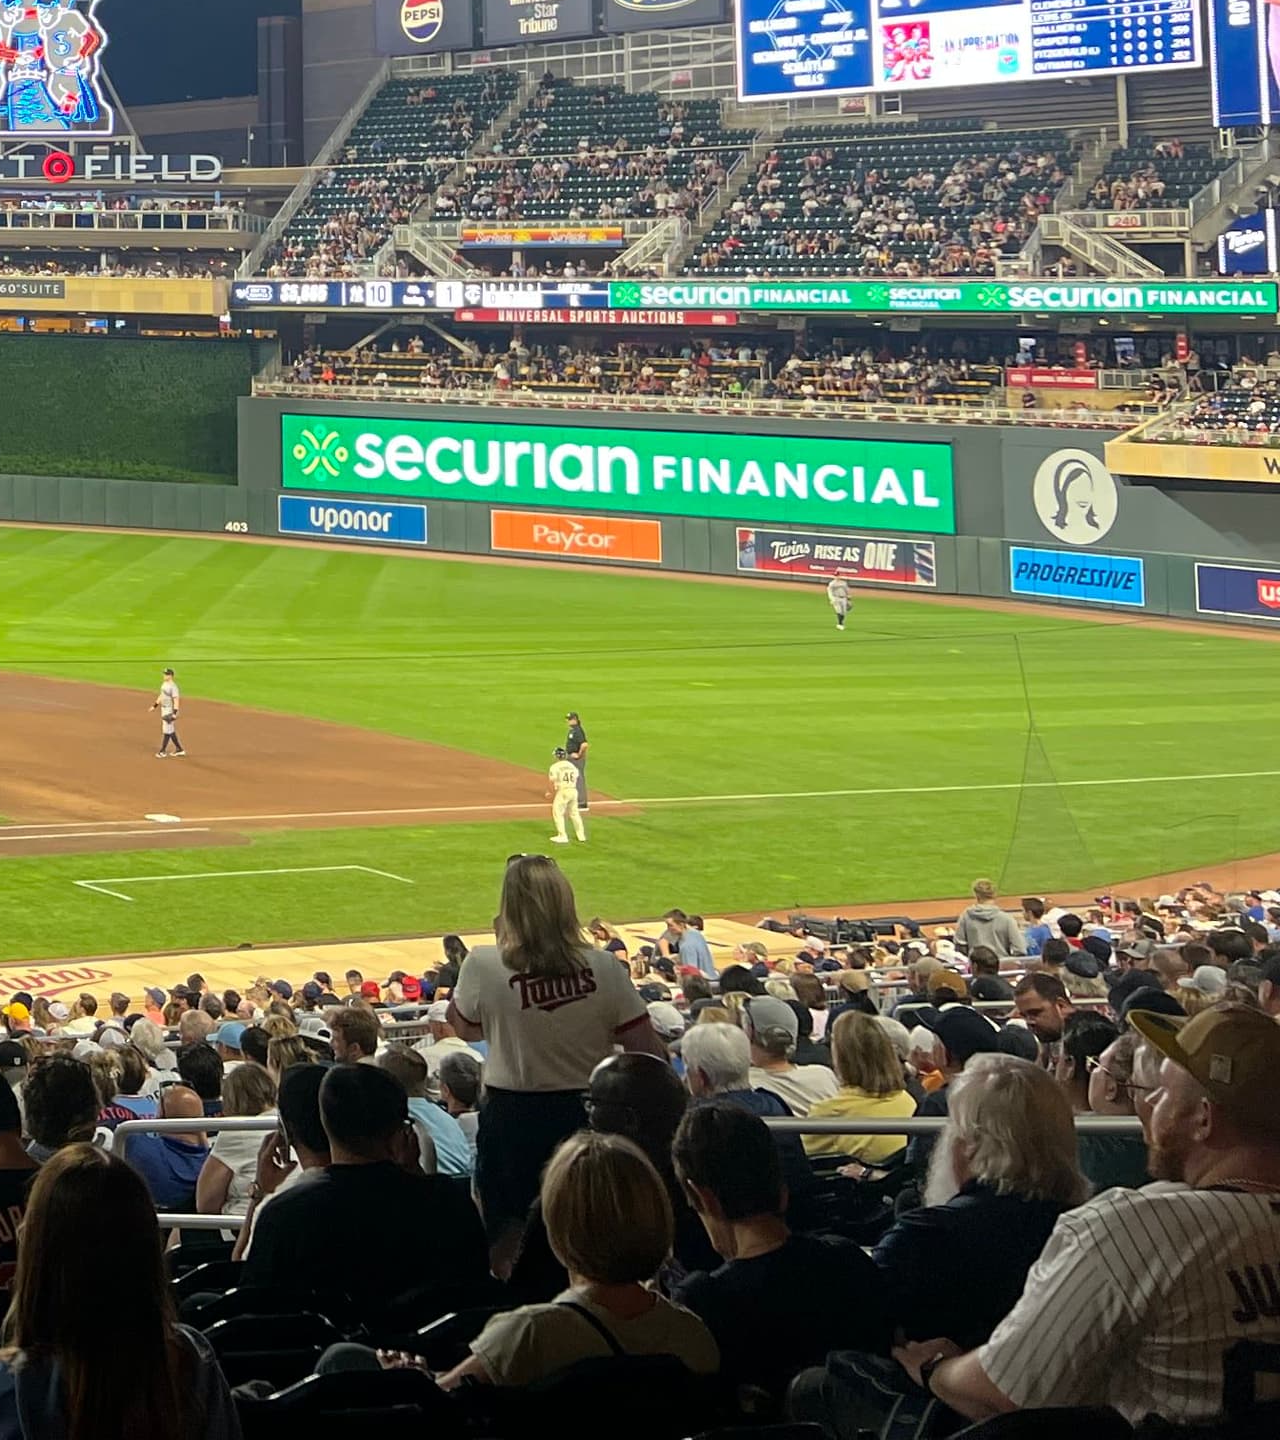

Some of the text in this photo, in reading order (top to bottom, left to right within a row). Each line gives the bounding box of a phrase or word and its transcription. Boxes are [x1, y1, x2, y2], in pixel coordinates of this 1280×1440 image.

[405, 7, 441, 23] PEPSI
[534, 2, 559, 18] Star
[518, 16, 558, 35] Tribune
[84, 155, 222, 181] FIELD
[21, 282, 59, 295] SUITE
[640, 283, 1268, 308] securian FINANCIAL securian securian FINANCIAL
[498, 309, 685, 324] UNIVERSAL SPORTS AUCTIONS
[352, 432, 940, 508] securian FINANCIAL
[224, 521, 248, 533] 403
[309, 505, 394, 535] uponor
[532, 522, 616, 552] Paycor
[770, 540, 810, 563] Twins
[814, 544, 842, 561] RISE
[843, 546, 860, 562] AS
[863, 542, 898, 570] ONE
[1015, 561, 1137, 591] PROGRESSIVE
